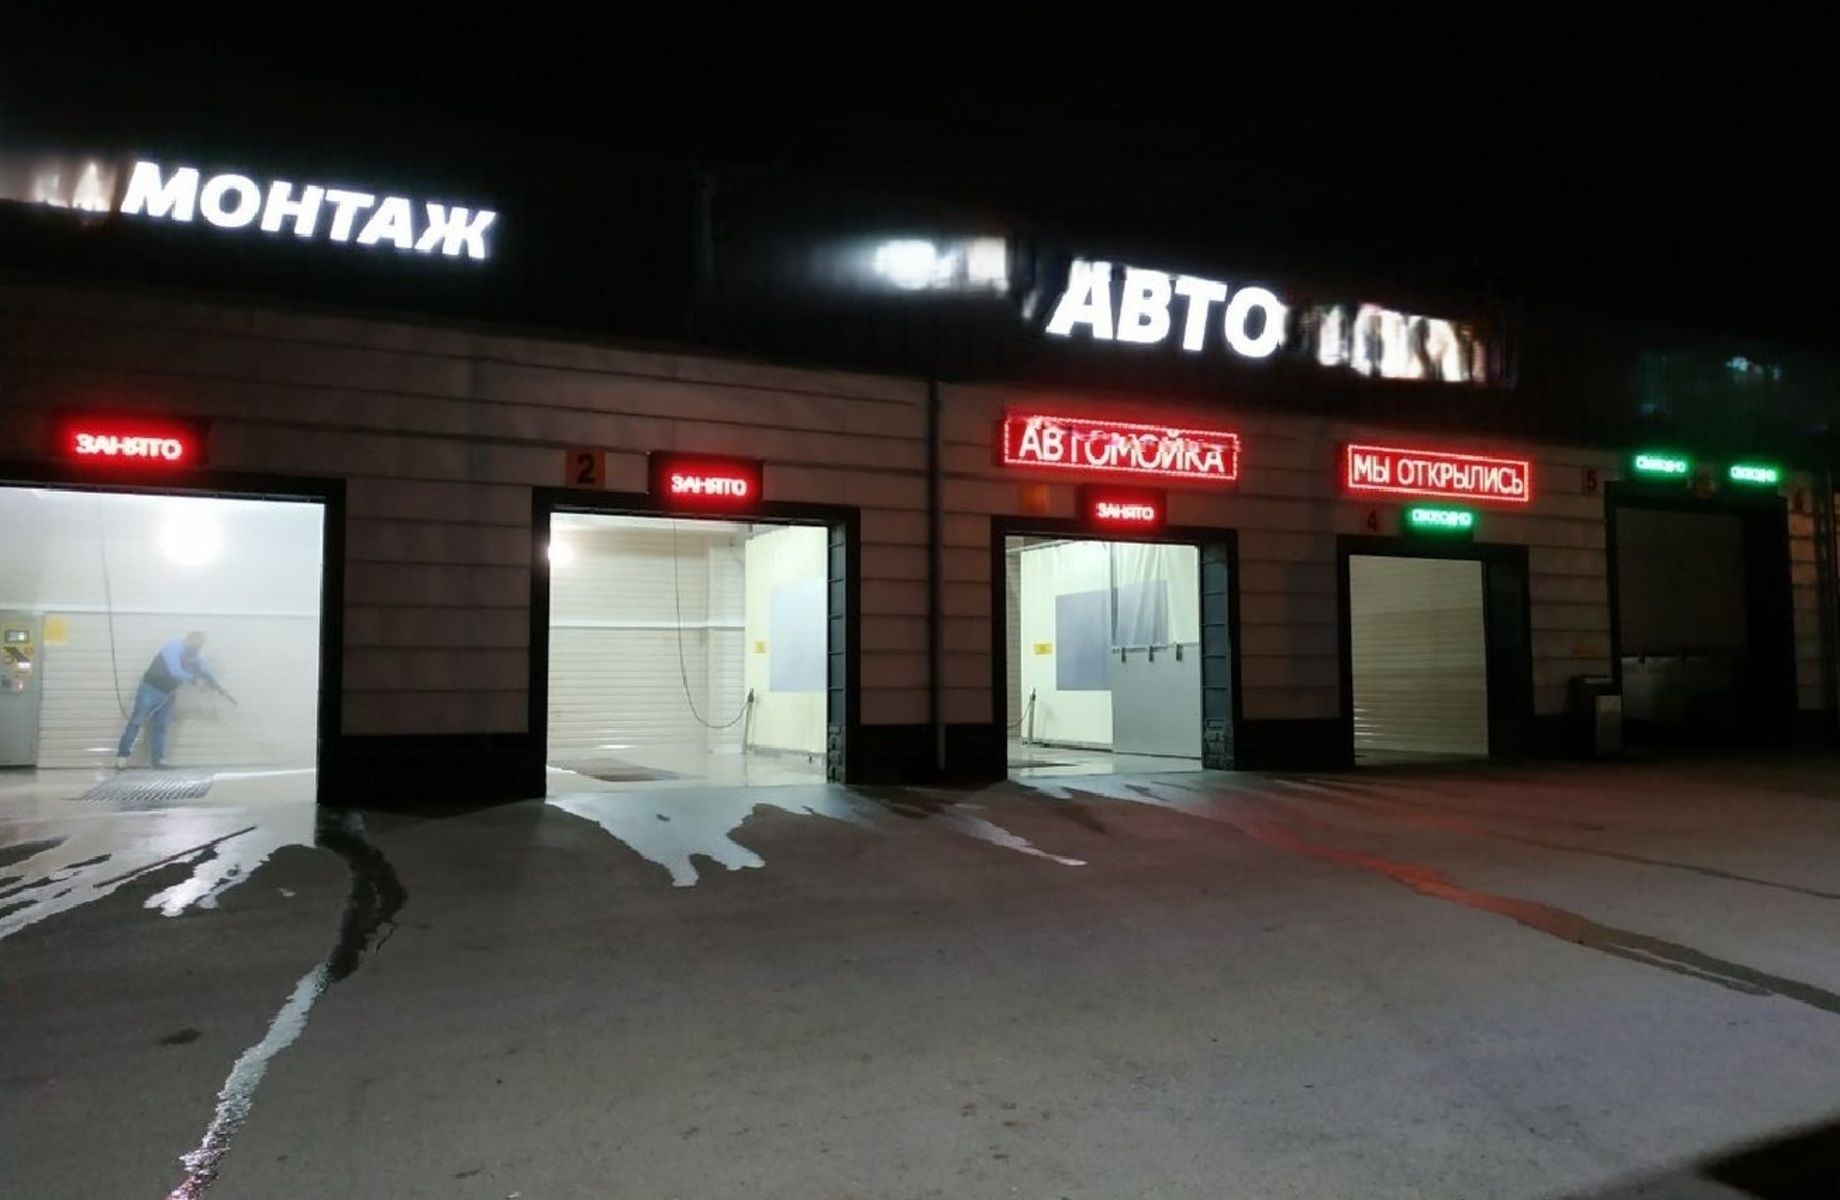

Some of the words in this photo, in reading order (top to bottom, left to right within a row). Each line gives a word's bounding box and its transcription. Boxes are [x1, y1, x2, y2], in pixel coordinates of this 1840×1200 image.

[120, 160, 496, 260] МОНТАЖ
[1046, 259, 1284, 357] АВТО
[577, 453, 595, 484] 2
[1354, 454, 1389, 483] МЫ
[1397, 458, 1523, 495] ОТКРЫЛИСЬ
[1586, 469, 1597, 491] 5
[1367, 508, 1380, 533] 4
